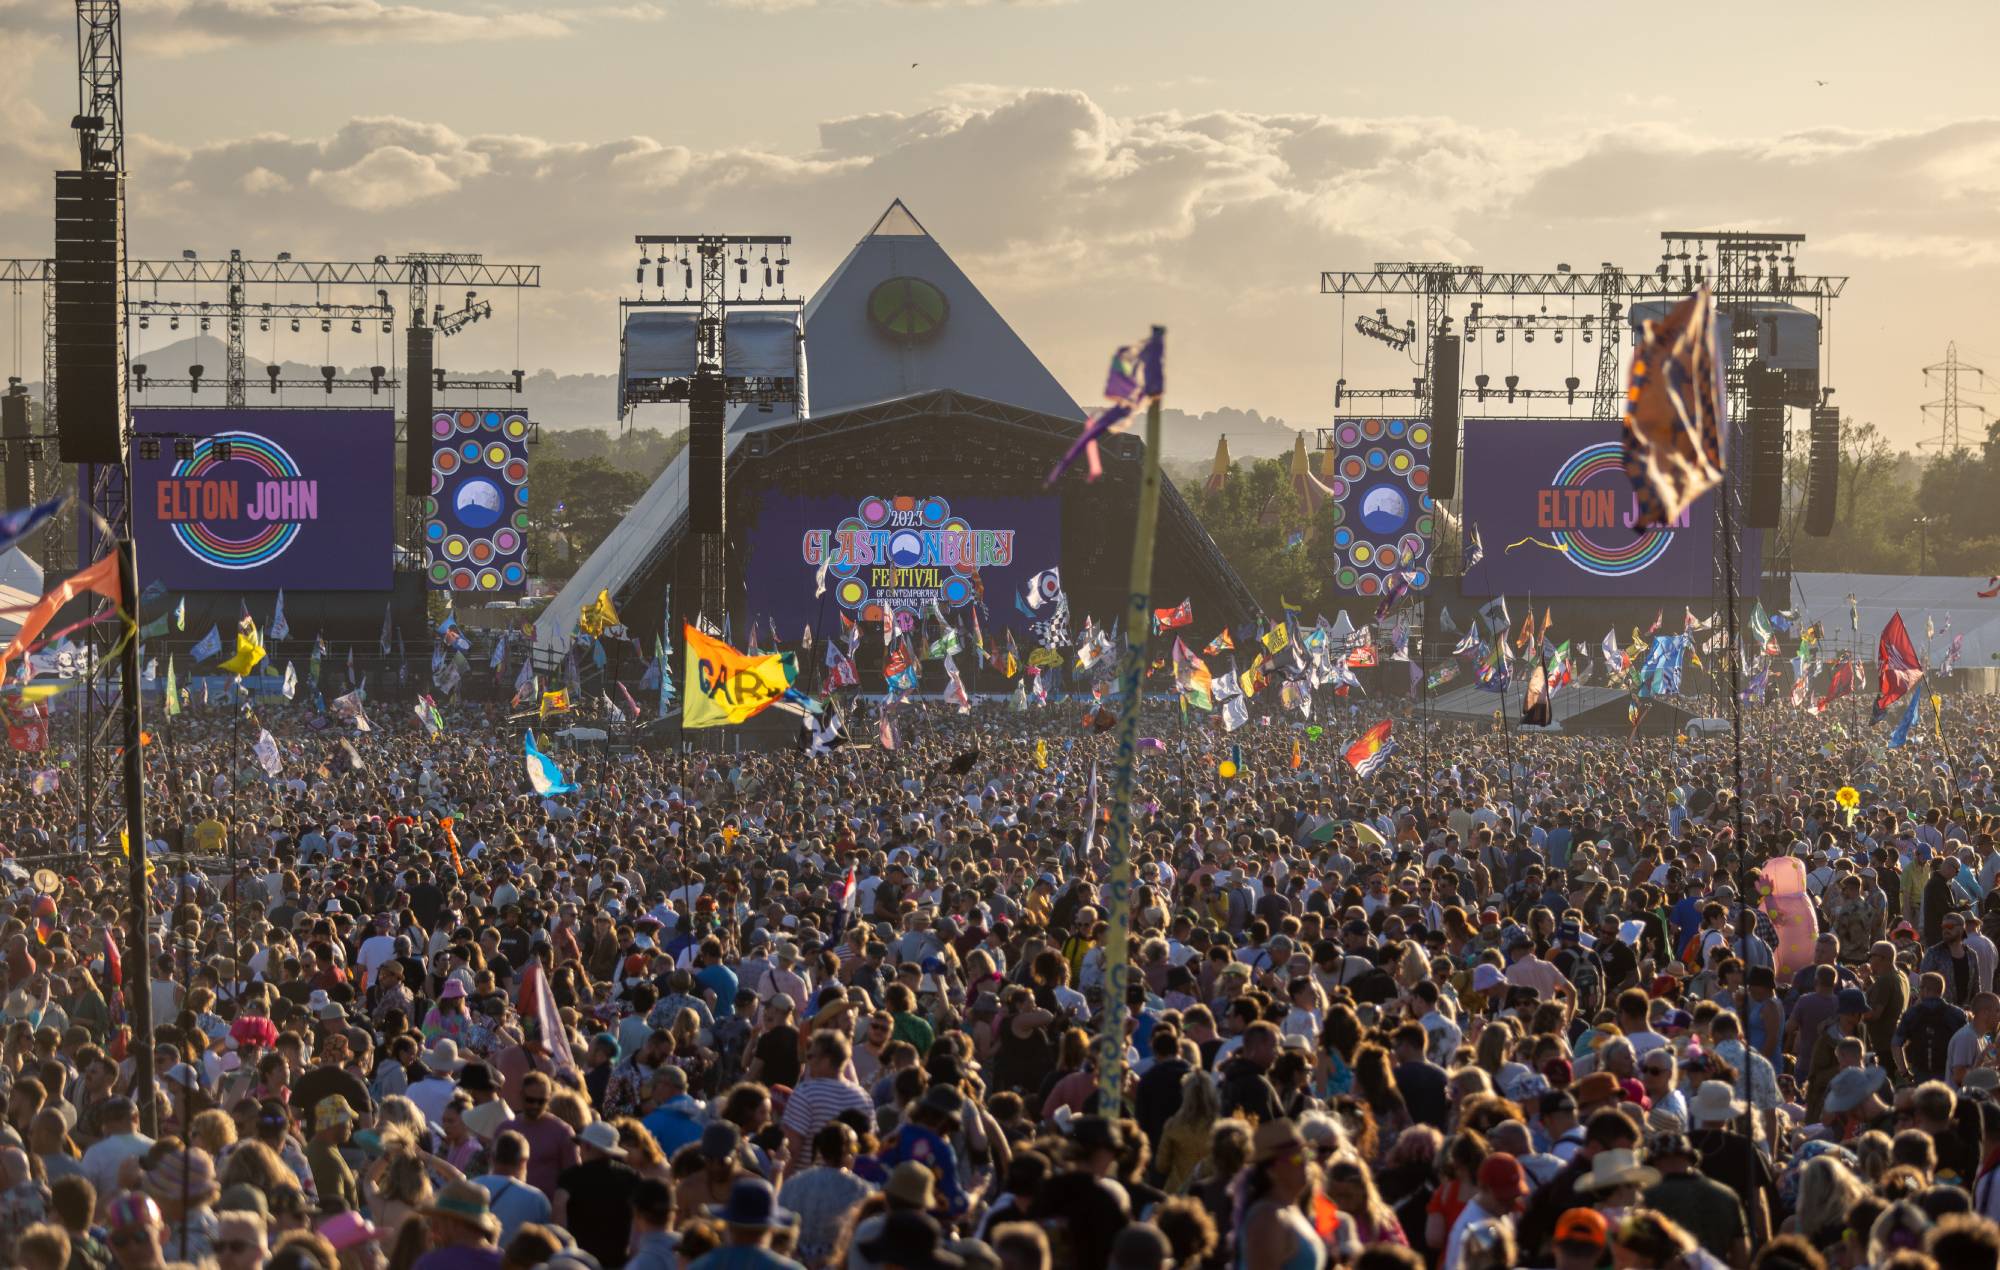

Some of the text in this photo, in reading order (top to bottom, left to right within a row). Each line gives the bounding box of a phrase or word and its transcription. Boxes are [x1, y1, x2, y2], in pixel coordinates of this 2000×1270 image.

[158, 480, 318, 521] ELTON JOHN
[891, 511, 923, 526] 2023
[1537, 490, 1615, 528] ELTON
[803, 529, 1015, 566] GLASTONBURY
